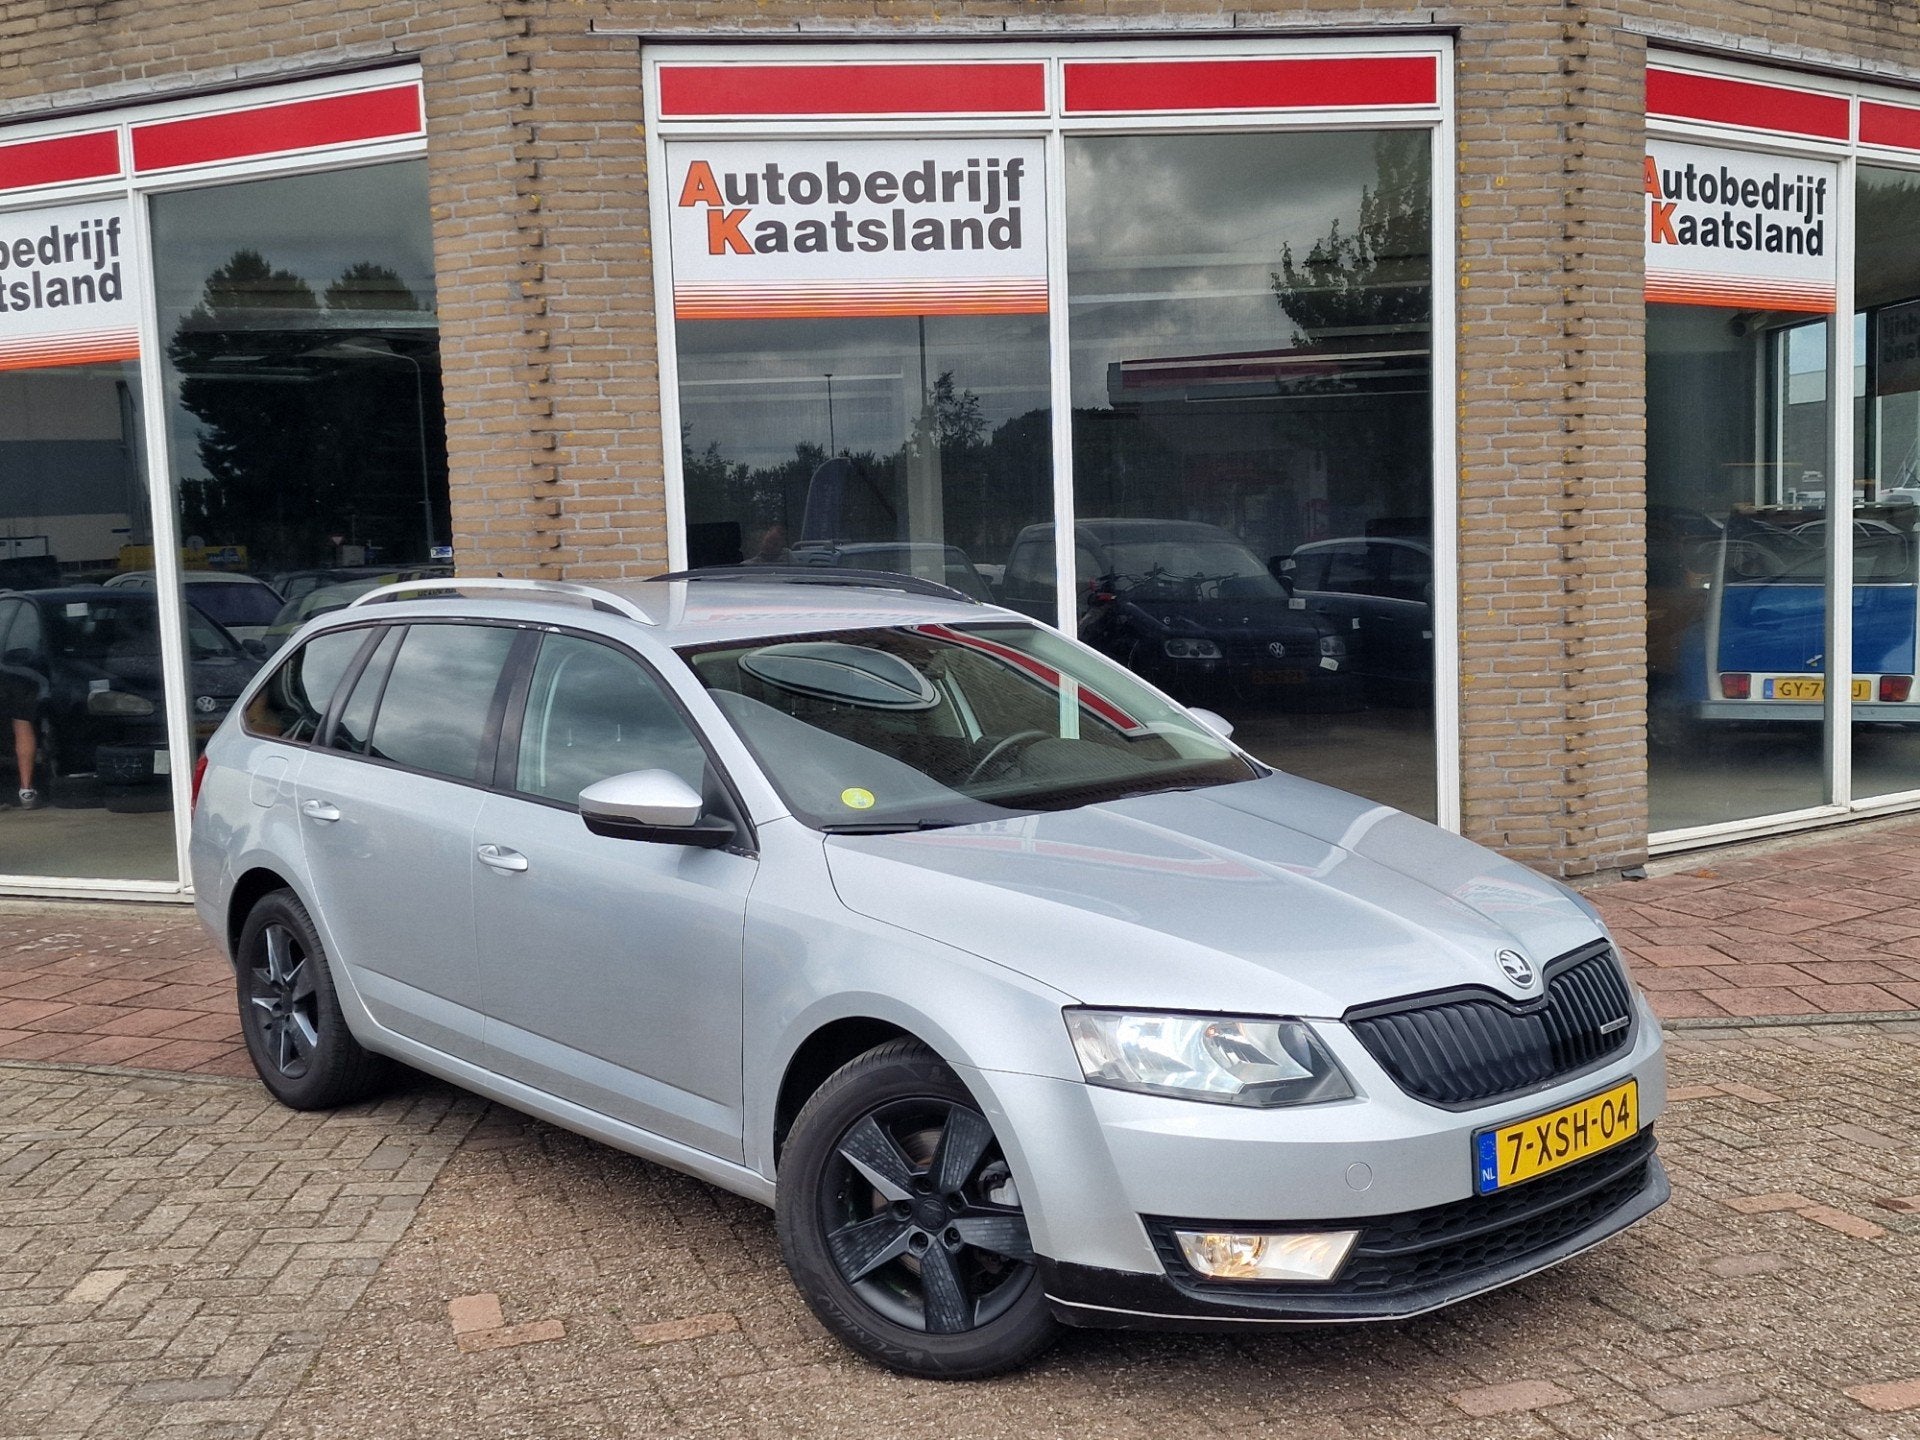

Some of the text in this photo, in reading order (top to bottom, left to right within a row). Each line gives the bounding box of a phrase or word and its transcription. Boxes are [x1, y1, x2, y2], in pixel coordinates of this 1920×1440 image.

[678, 158, 1025, 214] Autobedrijf
[706, 207, 1022, 255] Kaatsland
[1651, 200, 1824, 257] Kaatsland
[1482, 1092, 1630, 1182] NL 7-XSH-04
